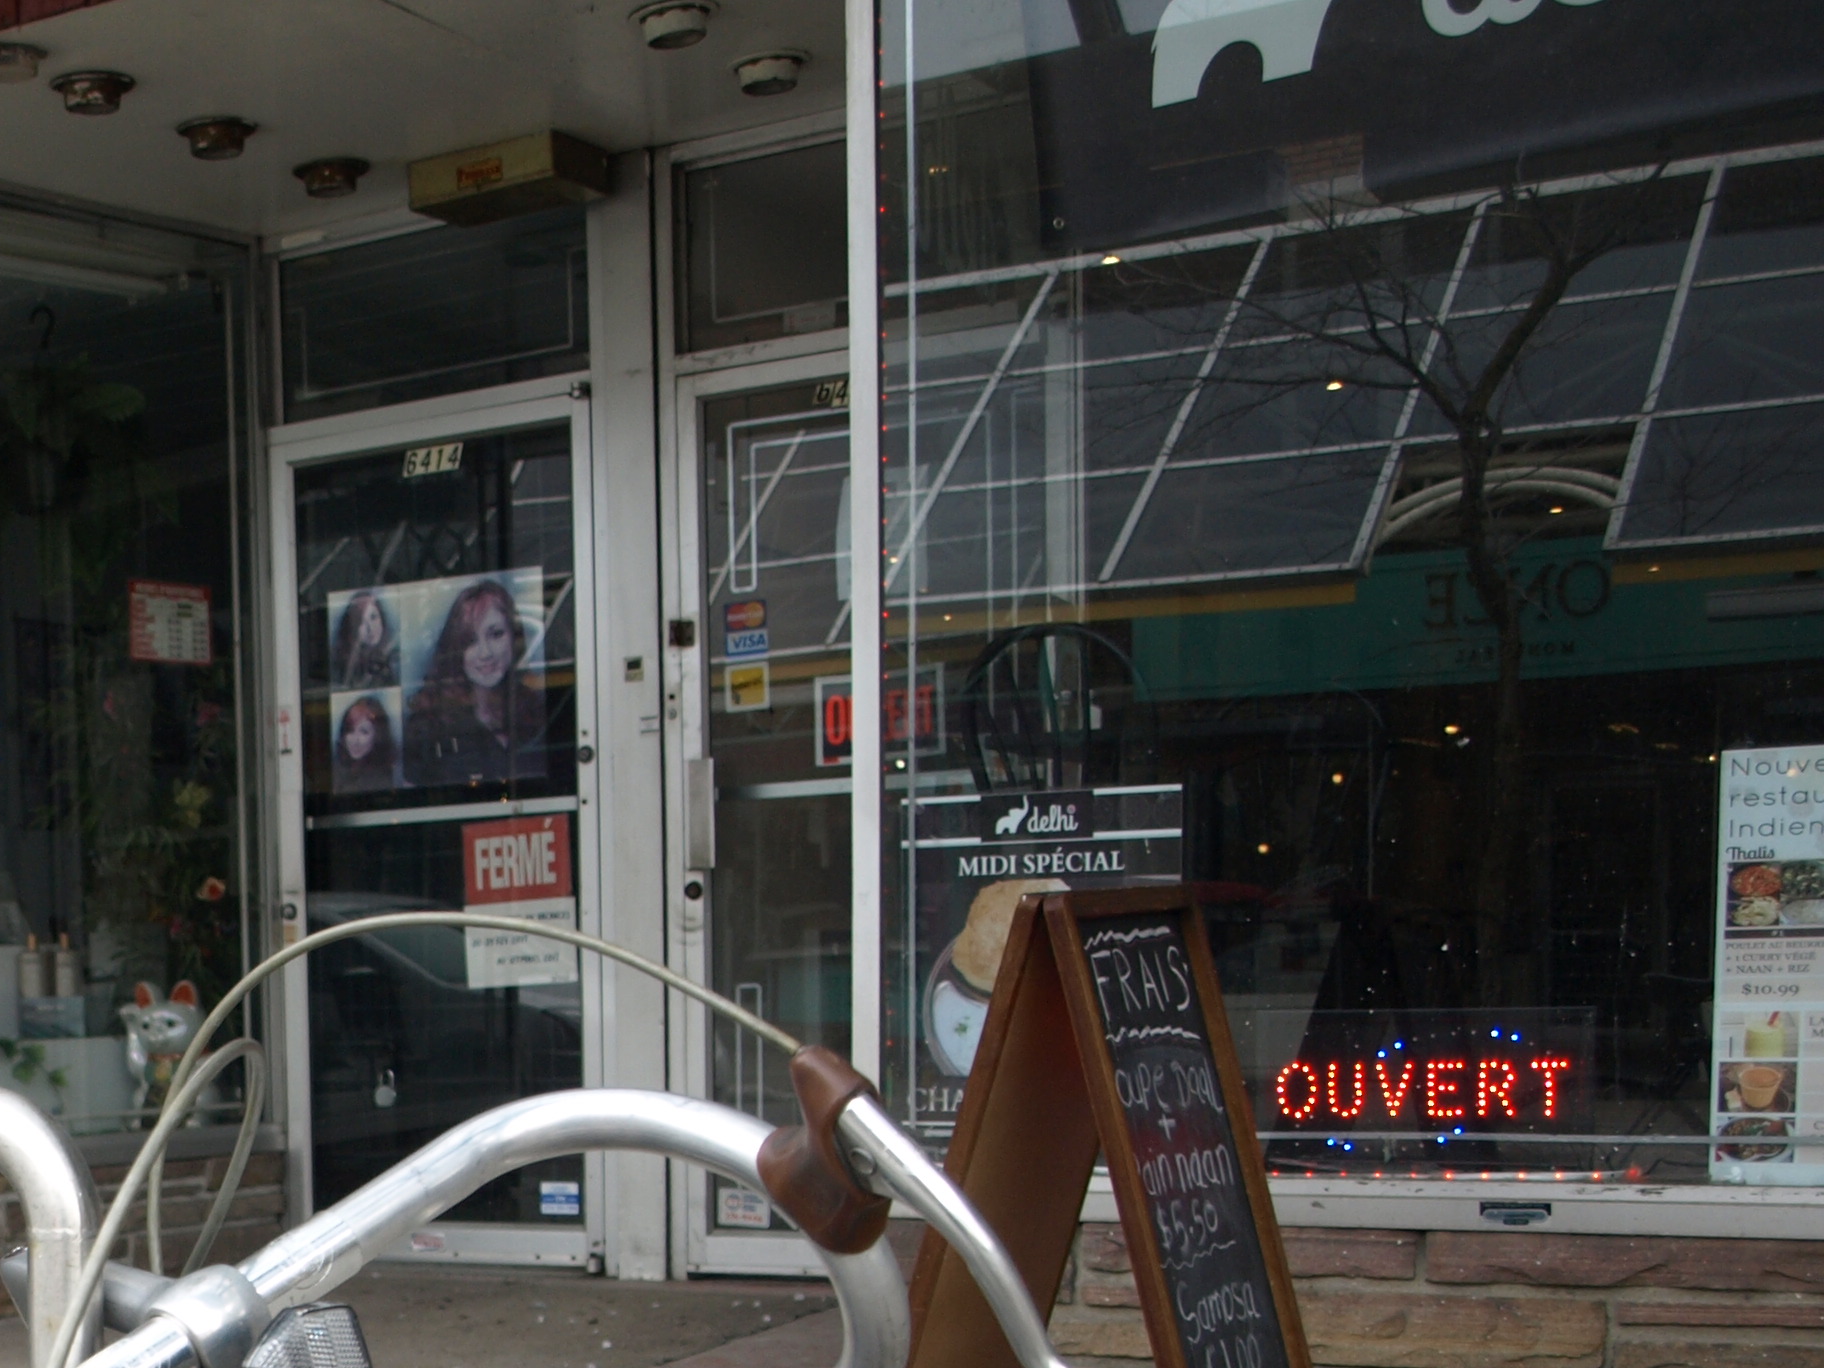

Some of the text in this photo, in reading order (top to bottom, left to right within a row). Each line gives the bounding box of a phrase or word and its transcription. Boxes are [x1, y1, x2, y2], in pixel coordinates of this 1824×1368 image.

[406, 446, 460, 475] 6414
[732, 633, 766, 649] VISA
[1027, 804, 1078, 833] delhi
[474, 818, 557, 891] FERMÉ
[1727, 846, 1775, 861] Thalis
[958, 847, 1125, 877] MIDI SPÉCIAL
[1726, 941, 1766, 949] POULET
[1742, 953, 1780, 961] CURRY
[1736, 964, 1773, 974] NAAN
[1788, 964, 1811, 973] RIZ
[1741, 983, 1800, 997] $10.99
[1275, 1060, 1571, 1119] OUVERT
